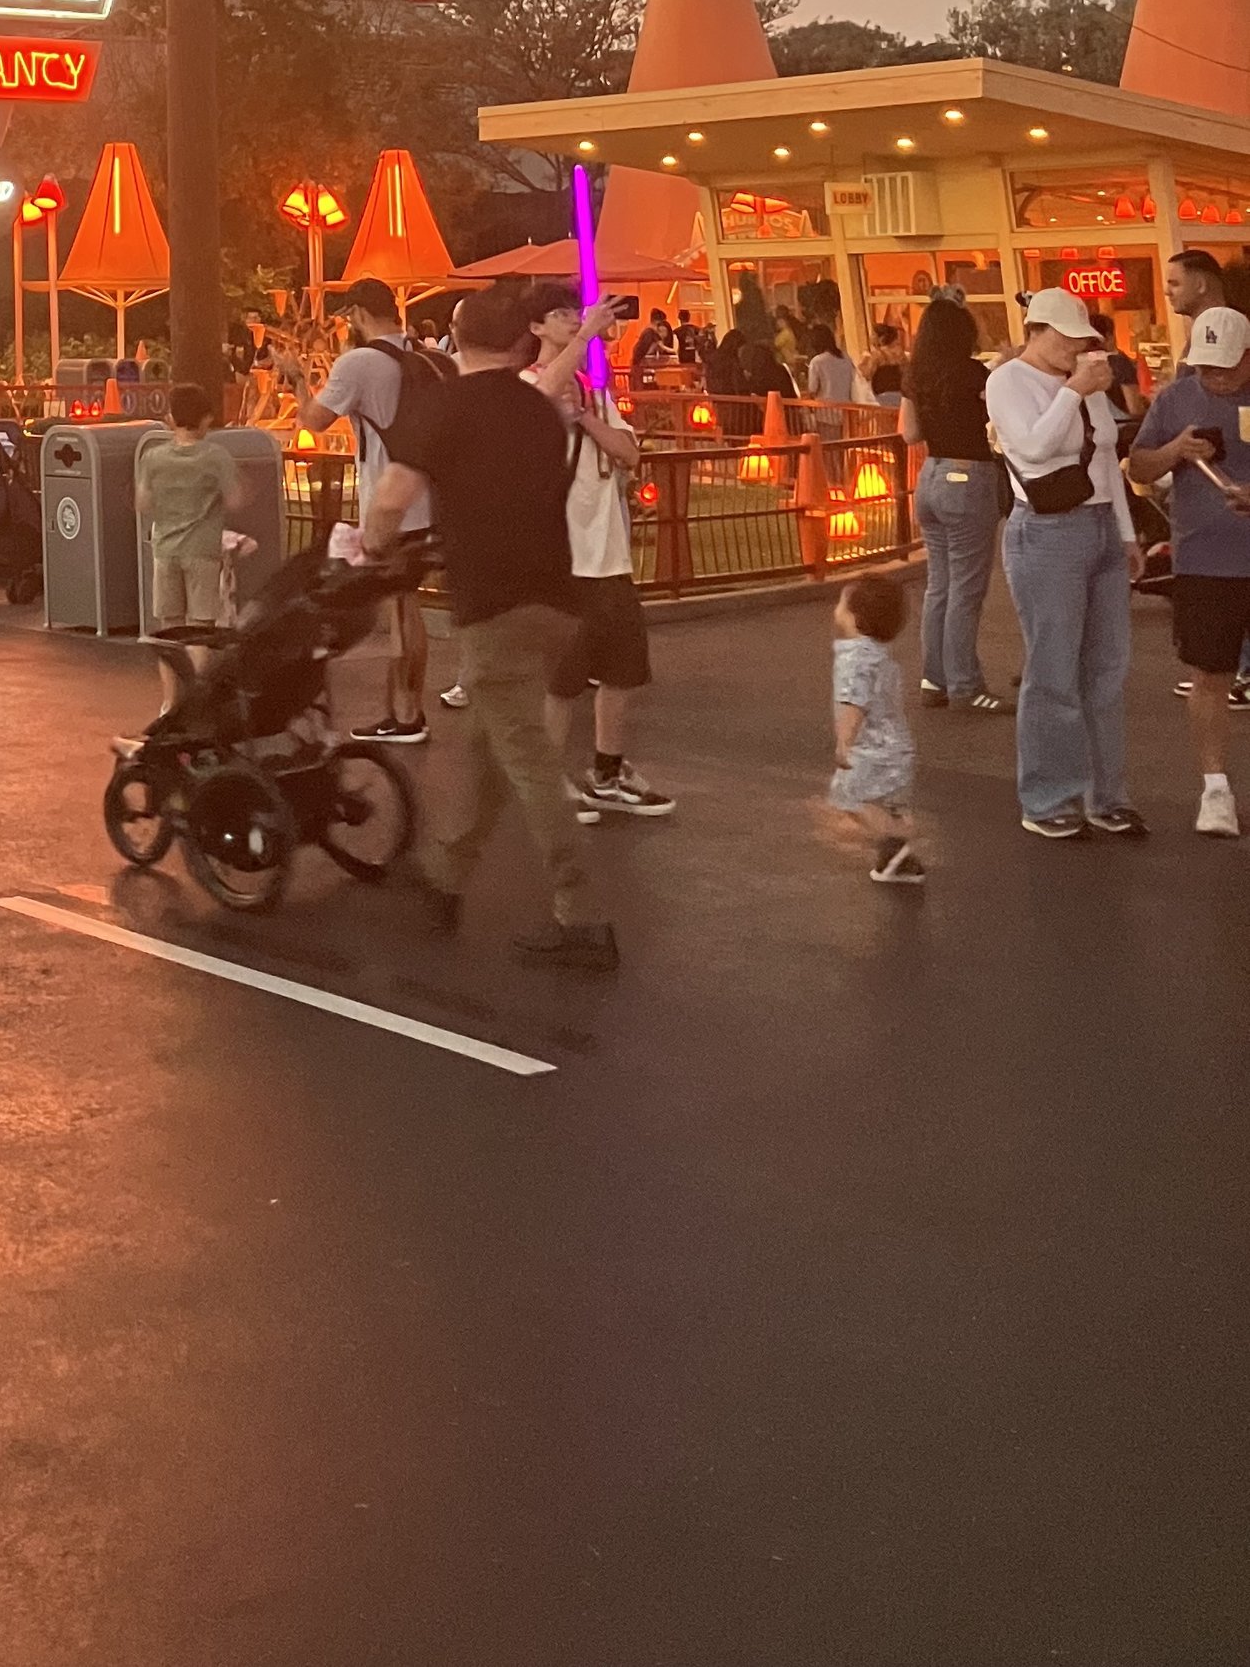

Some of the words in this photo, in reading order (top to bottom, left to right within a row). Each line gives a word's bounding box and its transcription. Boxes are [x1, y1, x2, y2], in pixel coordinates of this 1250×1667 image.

[832, 191, 869, 205] LOBBY
[1068, 270, 1125, 294] OFFICE
[1205, 325, 1218, 344] LA
